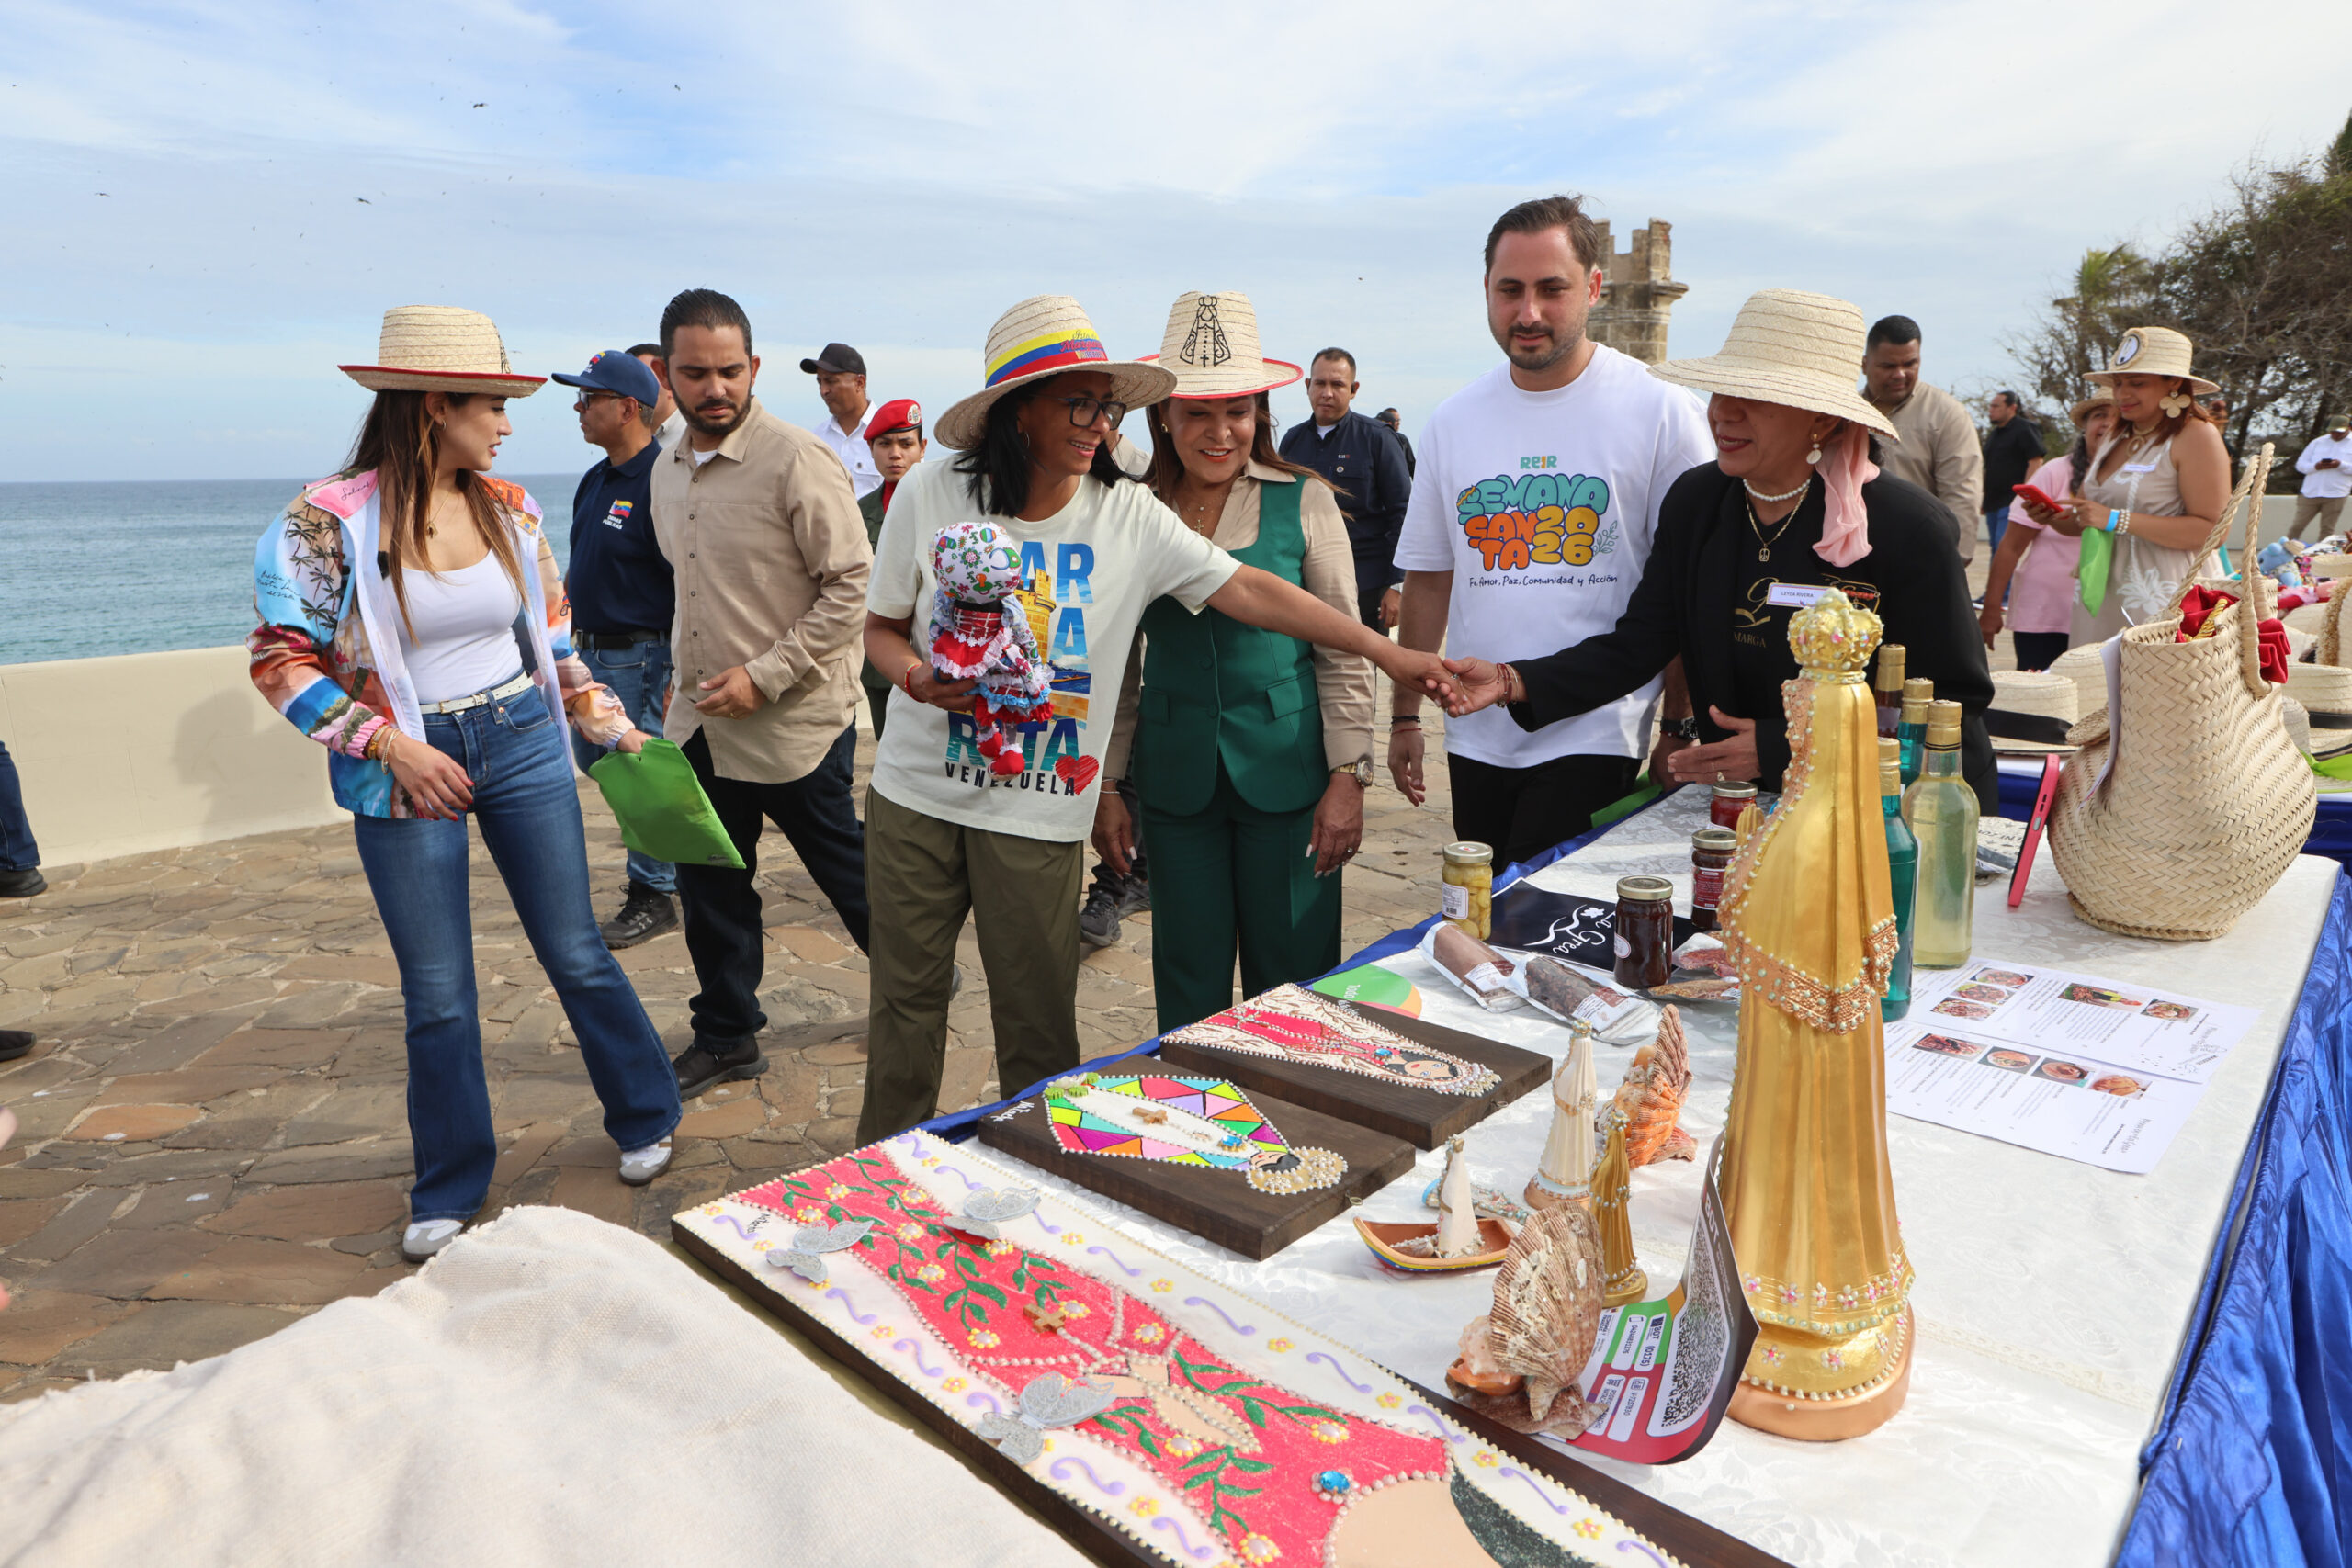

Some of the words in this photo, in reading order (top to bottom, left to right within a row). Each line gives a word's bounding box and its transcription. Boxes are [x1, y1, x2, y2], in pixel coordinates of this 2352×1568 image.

[1456, 473, 1610, 525] SEMANA
[1020, 541, 1094, 604] AR
[1522, 575, 1574, 586] Comunidad
[1577, 578, 1584, 587] y
[1588, 573, 1618, 585] Acción
[1639, 1345, 1655, 1367] (0175)
